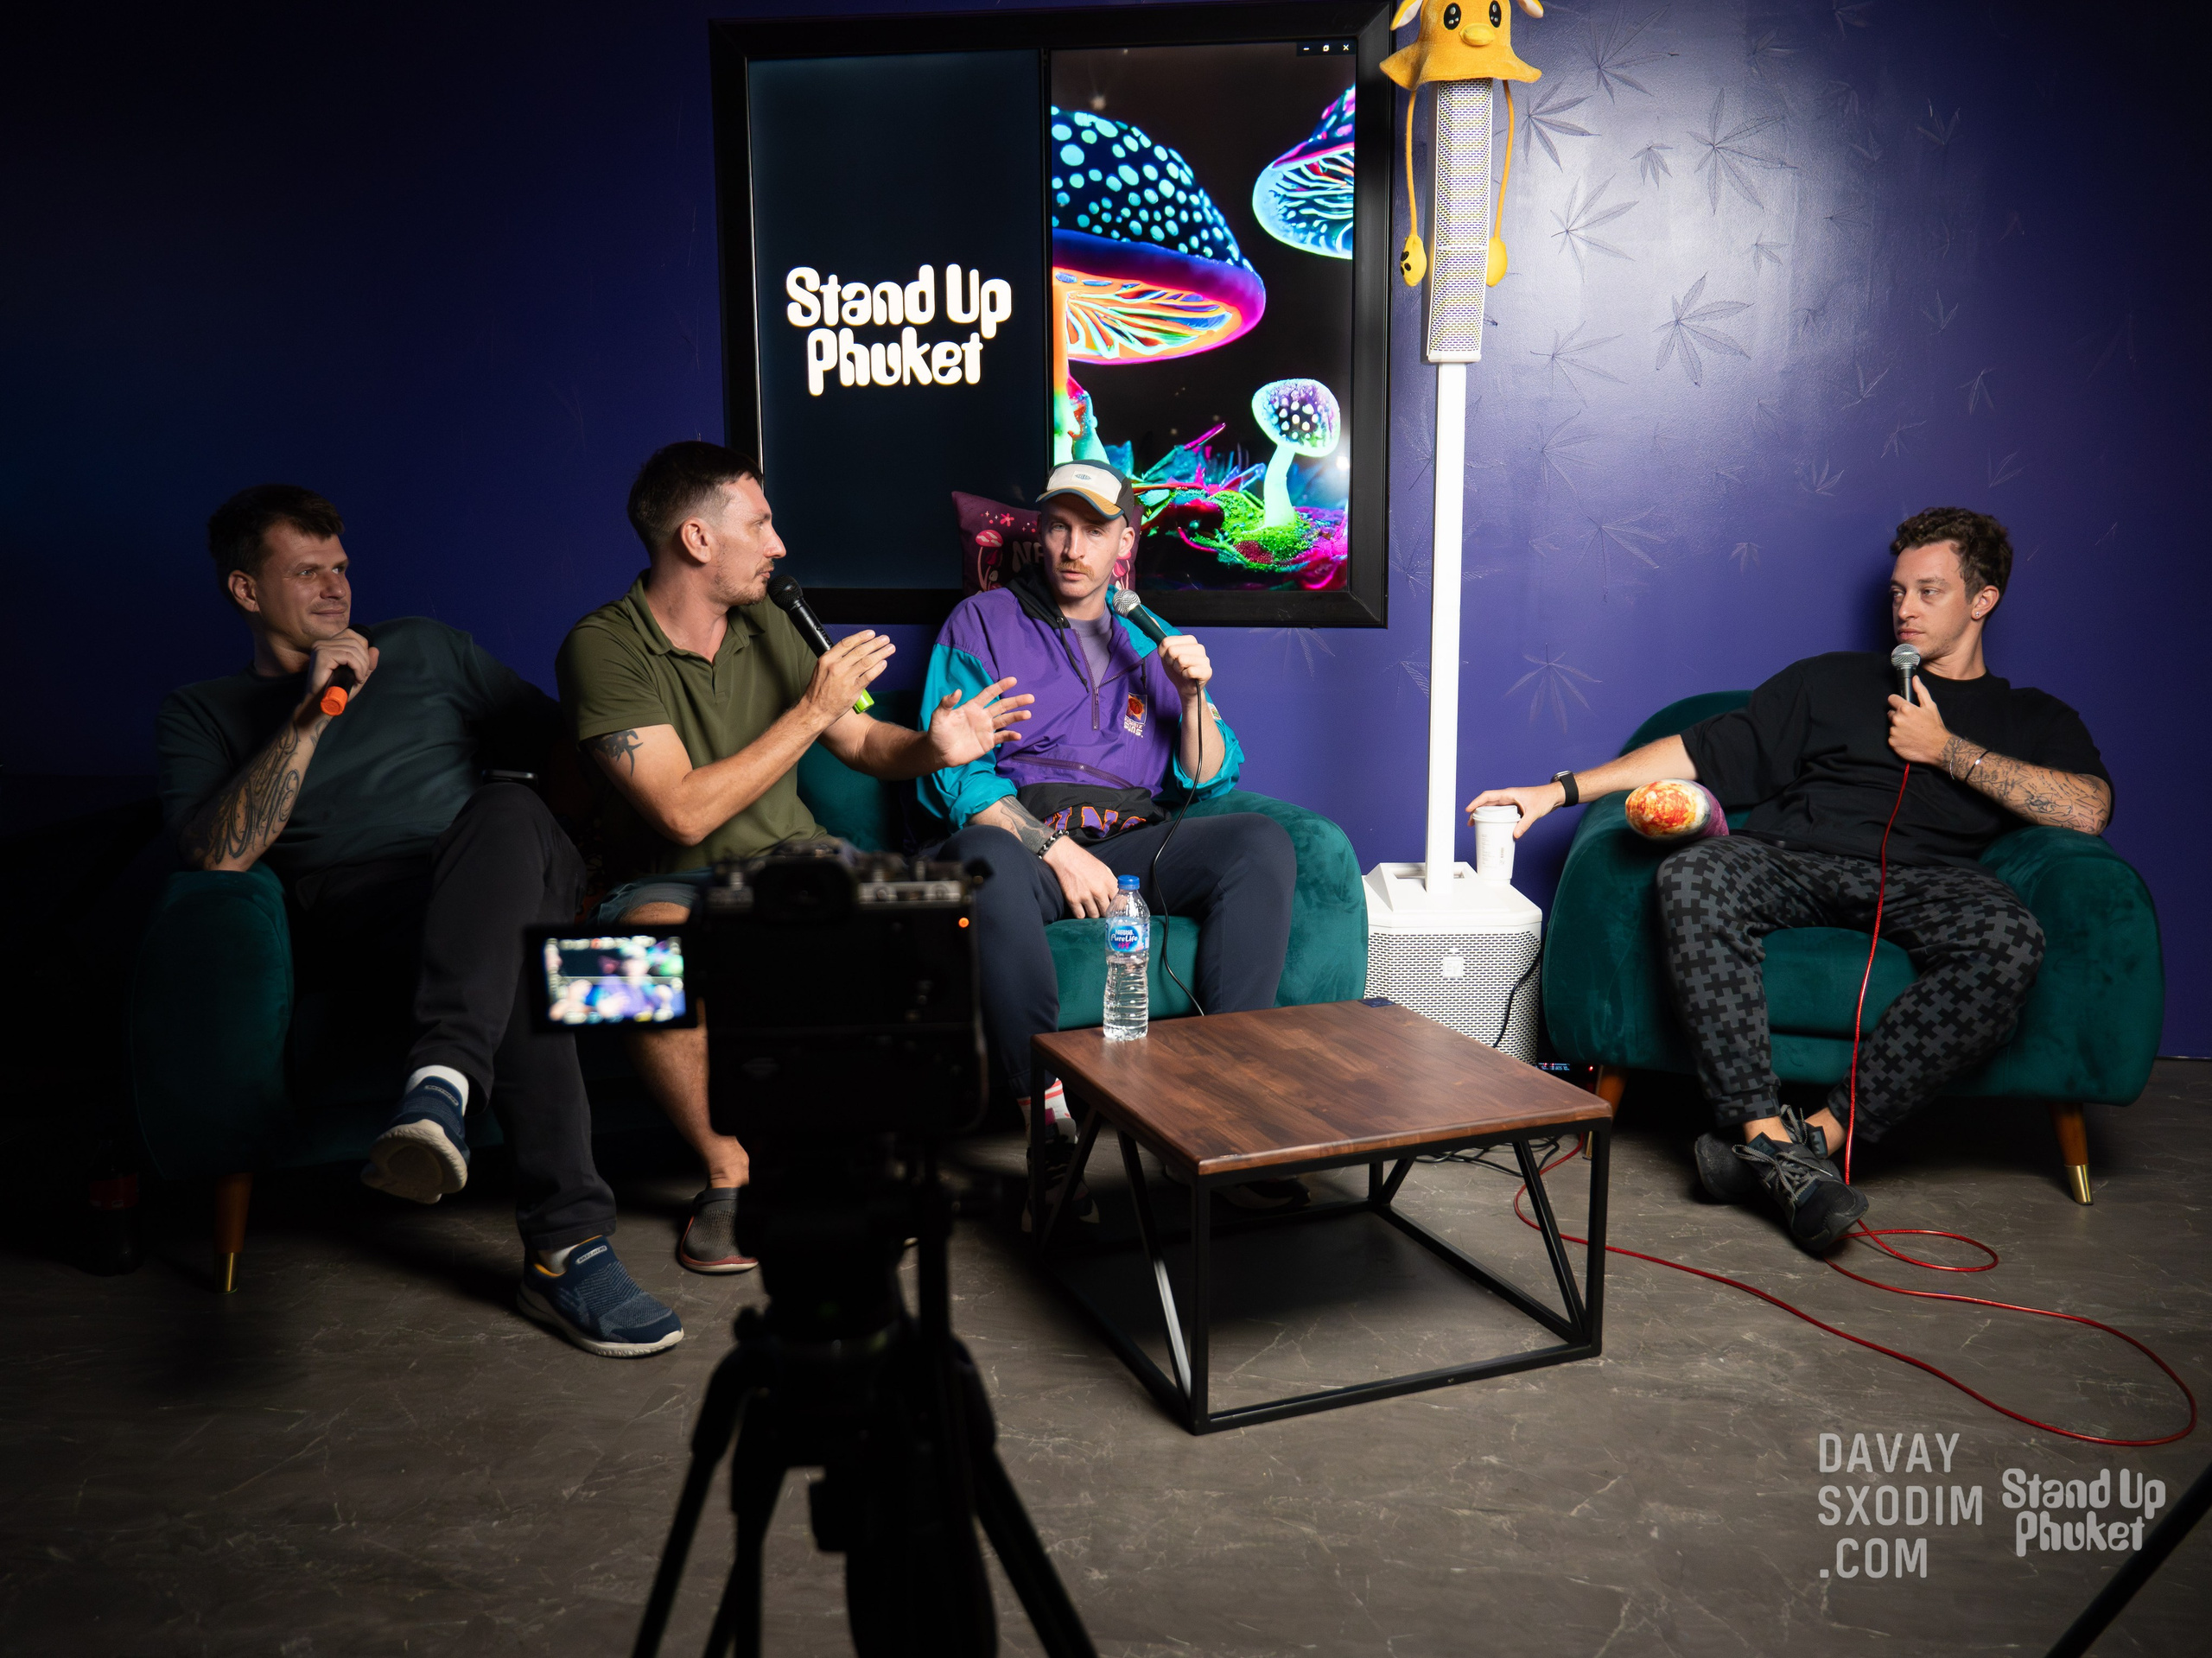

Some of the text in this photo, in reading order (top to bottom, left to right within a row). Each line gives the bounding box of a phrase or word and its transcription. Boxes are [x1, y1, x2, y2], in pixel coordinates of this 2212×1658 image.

[785, 264, 1012, 340] Stand Up
[807, 326, 984, 397] Phuket
